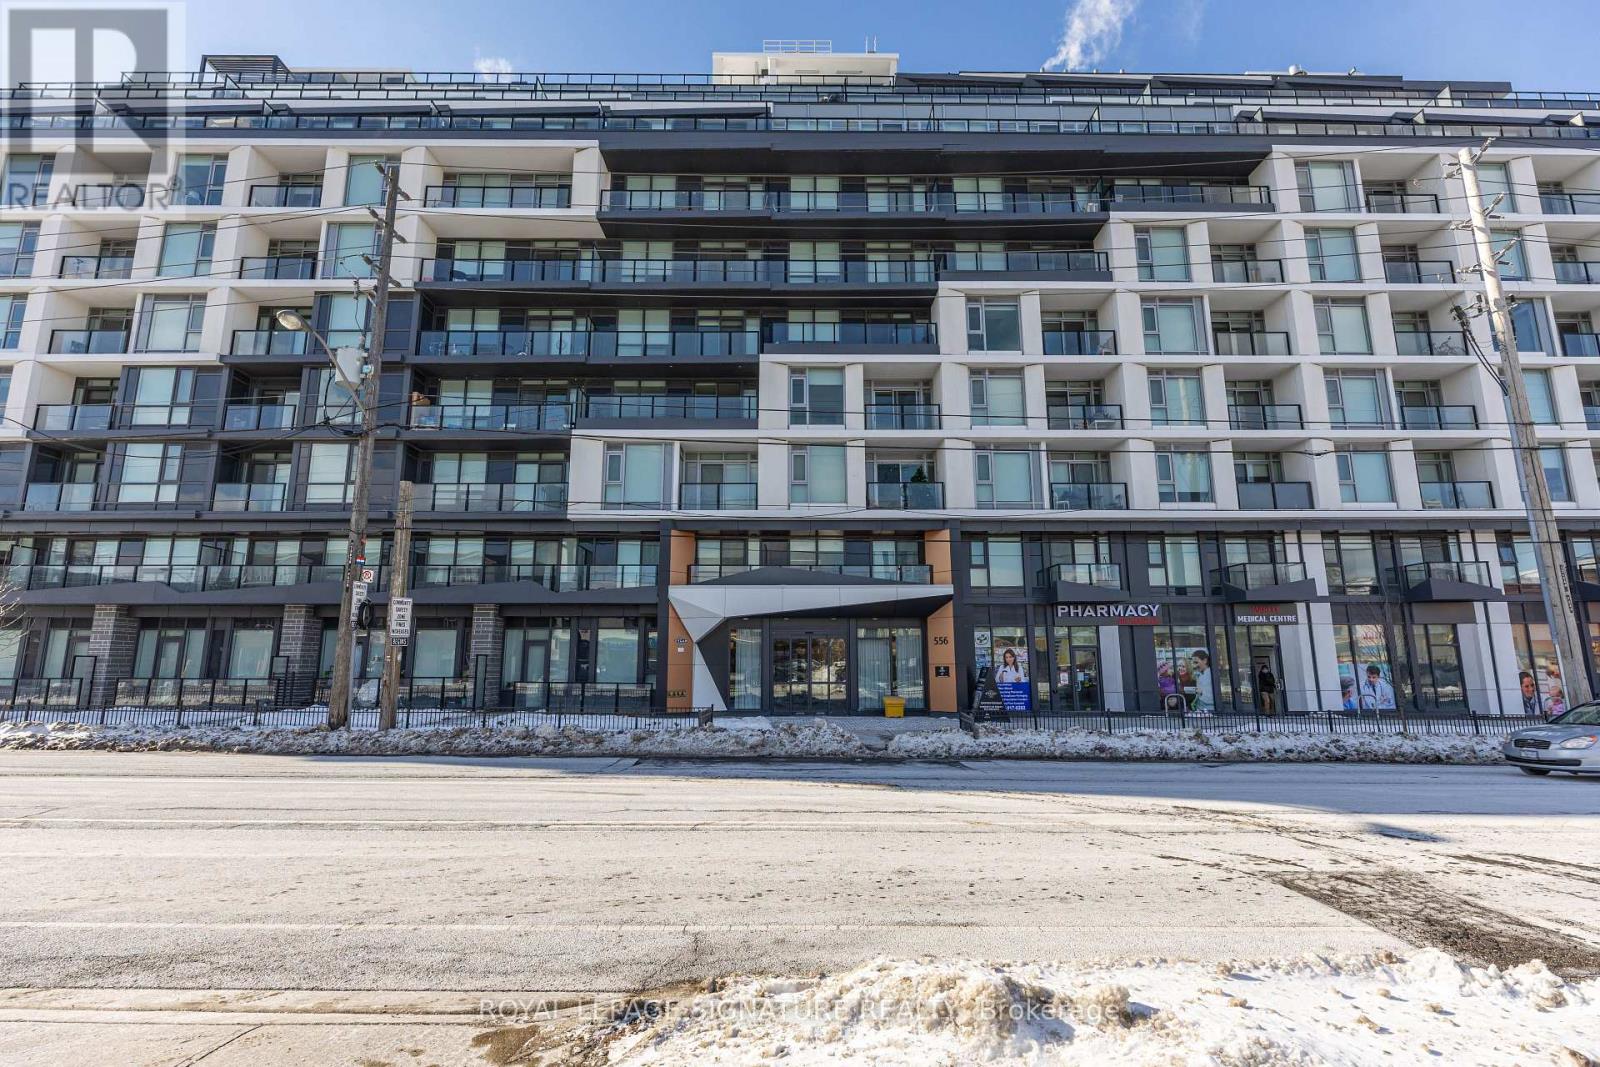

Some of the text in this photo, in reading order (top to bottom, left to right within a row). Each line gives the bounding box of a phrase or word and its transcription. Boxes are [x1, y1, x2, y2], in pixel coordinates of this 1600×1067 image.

[1057, 604, 1160, 617] PHARMACY
[1237, 615, 1268, 623] MEDICAL
[933, 636, 949, 646] 556
